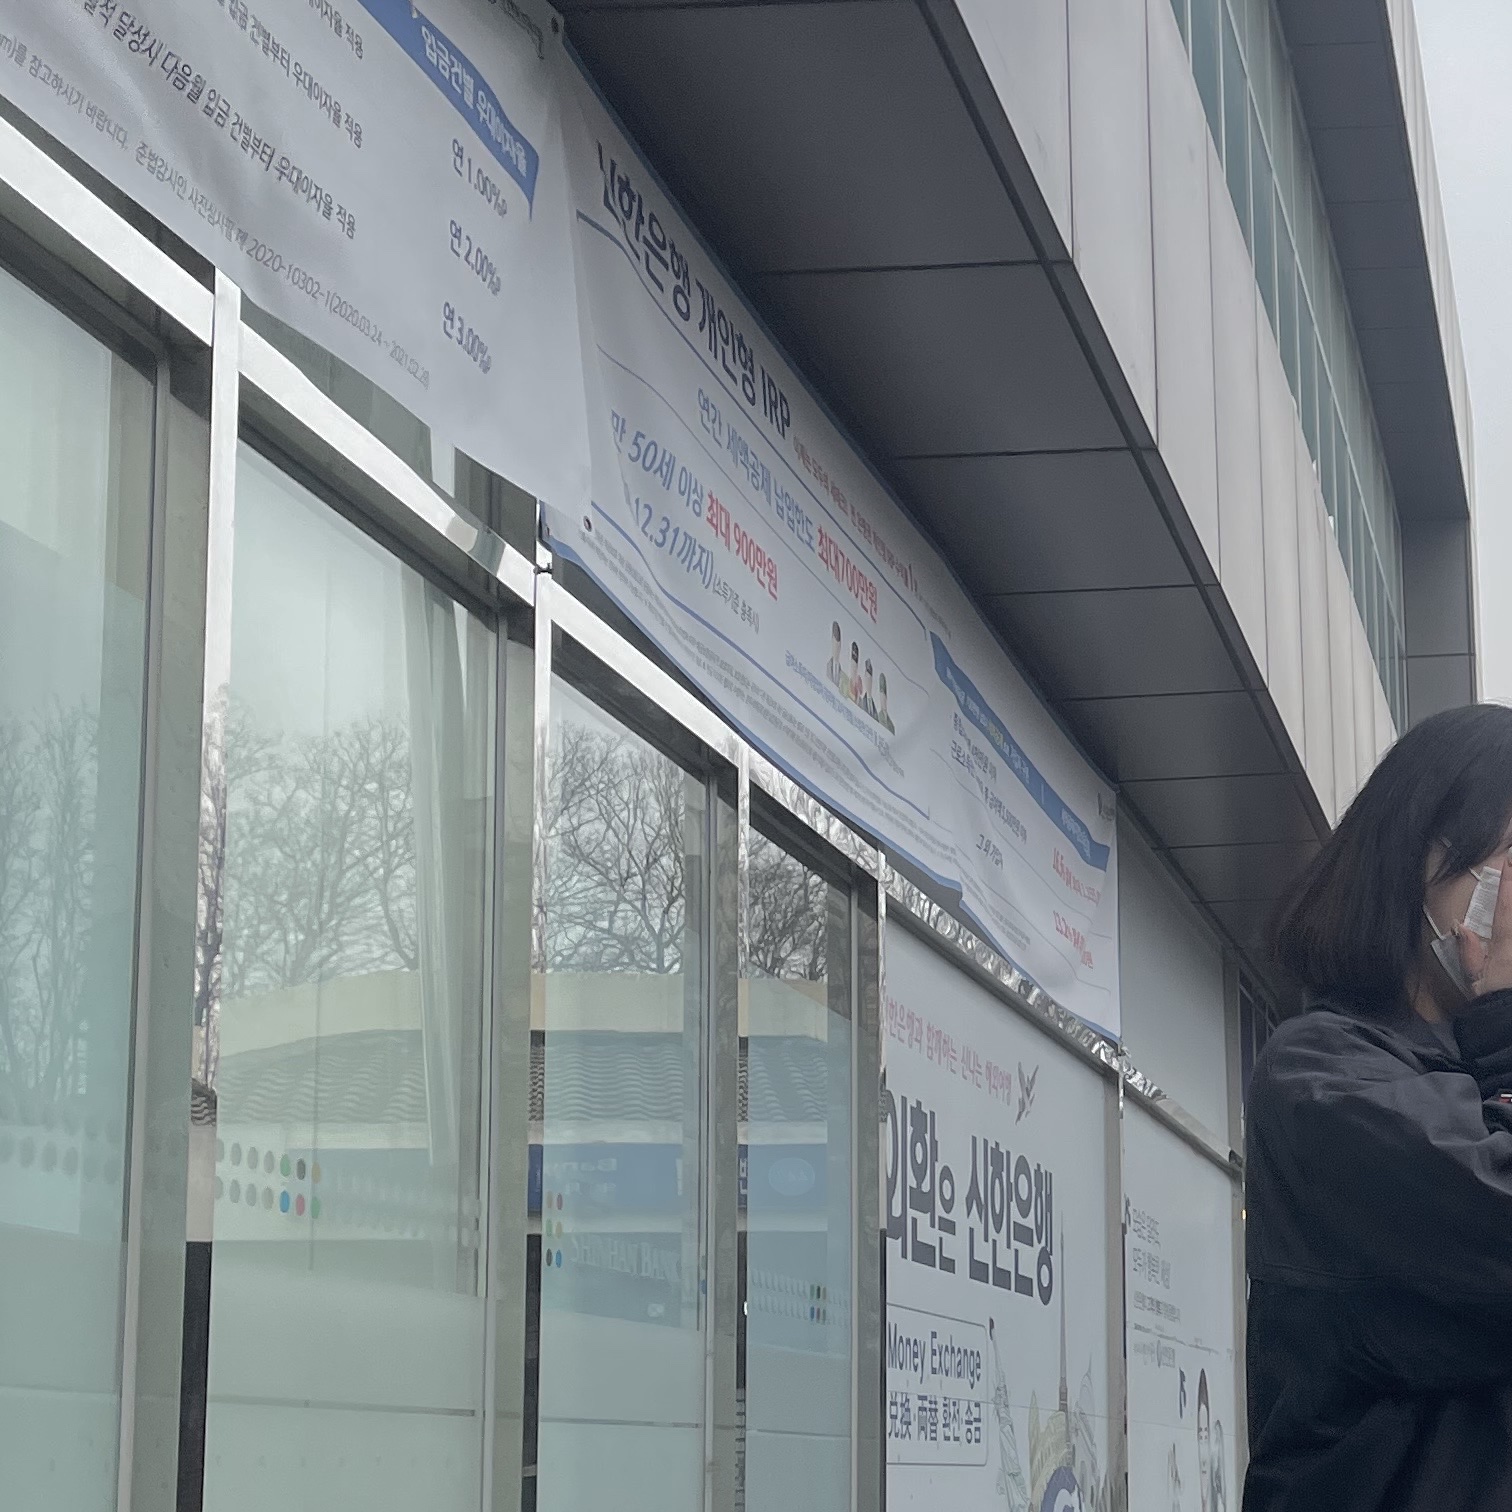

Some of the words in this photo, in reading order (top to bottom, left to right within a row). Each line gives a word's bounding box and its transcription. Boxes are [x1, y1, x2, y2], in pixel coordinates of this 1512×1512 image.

[250, 14, 290, 77] 건별부터
[292, 62, 342, 128] 우대이자율
[344, 112, 362, 149] 적용
[344, 23, 363, 60] 적용
[421, 25, 474, 110] 입금건별
[28, 54, 84, 113] 참고하시기
[135, 140, 188, 200] 준법감시인
[113, 11, 167, 67] 달성시
[160, 51, 207, 104] 다음월
[202, 88, 231, 128] 입금
[230, 112, 275, 171] 건별부터
[274, 156, 333, 220] 우대이자율
[335, 203, 356, 239] 적용
[452, 138, 463, 177] 연
[450, 219, 462, 257] 연
[443, 301, 454, 340] 연
[695, 277, 756, 407] 개인형
[760, 364, 791, 440] IRP
[628, 431, 677, 491] 50세
[677, 465, 704, 518] 이상
[706, 489, 731, 552] 최대
[733, 522, 778, 601] 900만원
[698, 387, 723, 449] 연간
[773, 473, 816, 554] 납입한도
[965, 1135, 1053, 1306] 신한은행
[888, 1321, 926, 1384] Money
[931, 1331, 981, 1389] Exchange
